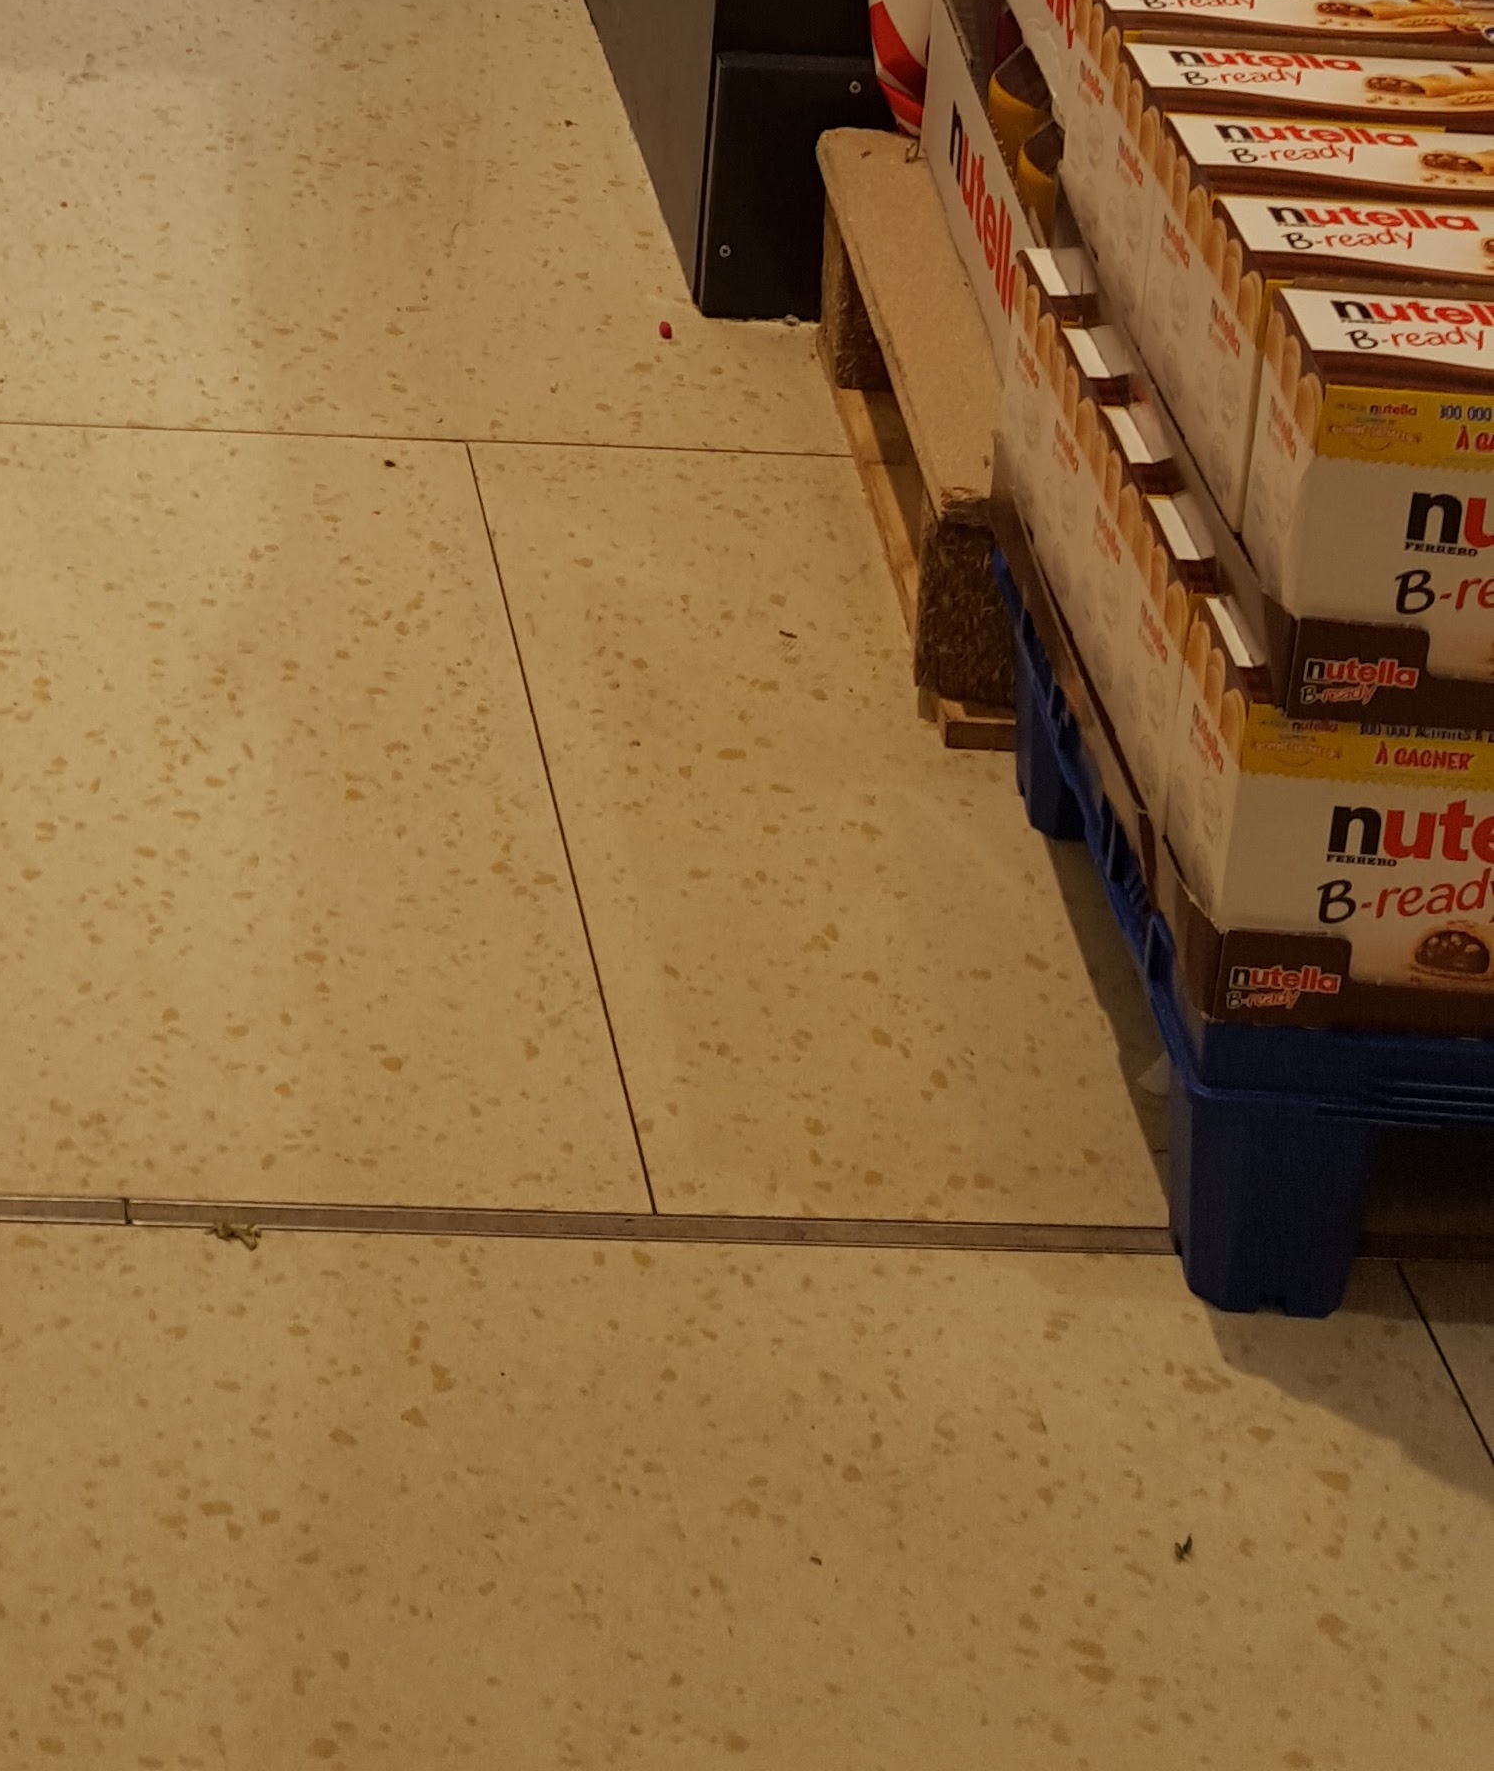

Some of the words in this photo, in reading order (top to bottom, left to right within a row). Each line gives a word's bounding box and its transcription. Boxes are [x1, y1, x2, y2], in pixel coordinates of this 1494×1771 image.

[1168, 51, 1363, 72] nutella
[1181, 68, 1303, 86] B-ready
[1215, 124, 1418, 147] nutella
[1228, 145, 1355, 163] B-ready
[1268, 206, 1479, 231] nutella
[1281, 229, 1413, 249] B-ready
[1345, 327, 1485, 350] B-ready
[1403, 541, 1479, 557] FERRERO
[1394, 568, 1494, 615] B-re
[1303, 657, 1419, 690] nutella
[1394, 748, 1476, 772] GAGNER
[1326, 799, 1494, 862] nute
[1325, 854, 1397, 867] FERRERO
[1317, 868, 1494, 923] B-read
[1228, 964, 1342, 995] nutella
